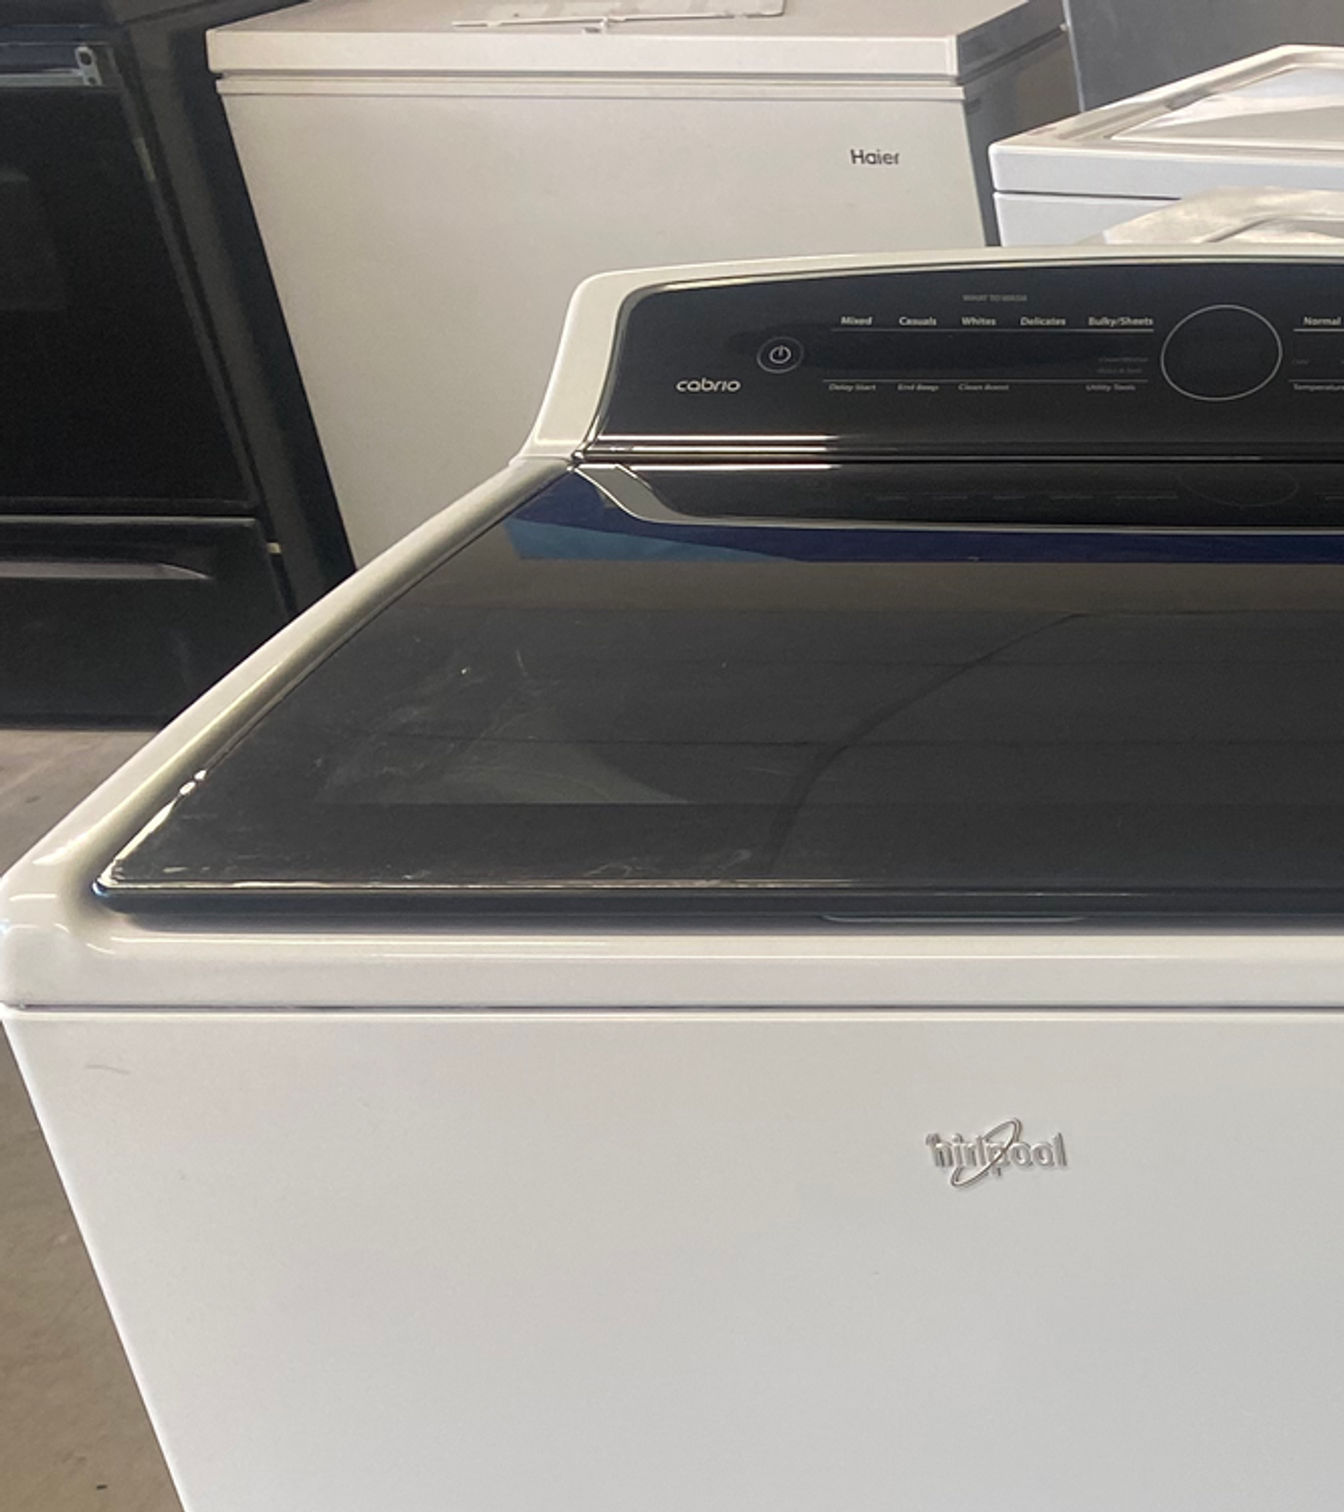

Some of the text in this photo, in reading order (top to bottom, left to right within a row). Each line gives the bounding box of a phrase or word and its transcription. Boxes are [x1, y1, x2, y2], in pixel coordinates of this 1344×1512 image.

[850, 148, 900, 165] Haier
[841, 316, 873, 326] Mixed
[899, 316, 937, 326] Casuals
[961, 316, 997, 326] Whites
[1020, 316, 1066, 326] Delicates
[1088, 316, 1154, 328] Bulky/Sheets
[1303, 316, 1342, 326] Normal
[675, 377, 741, 392] cabrio
